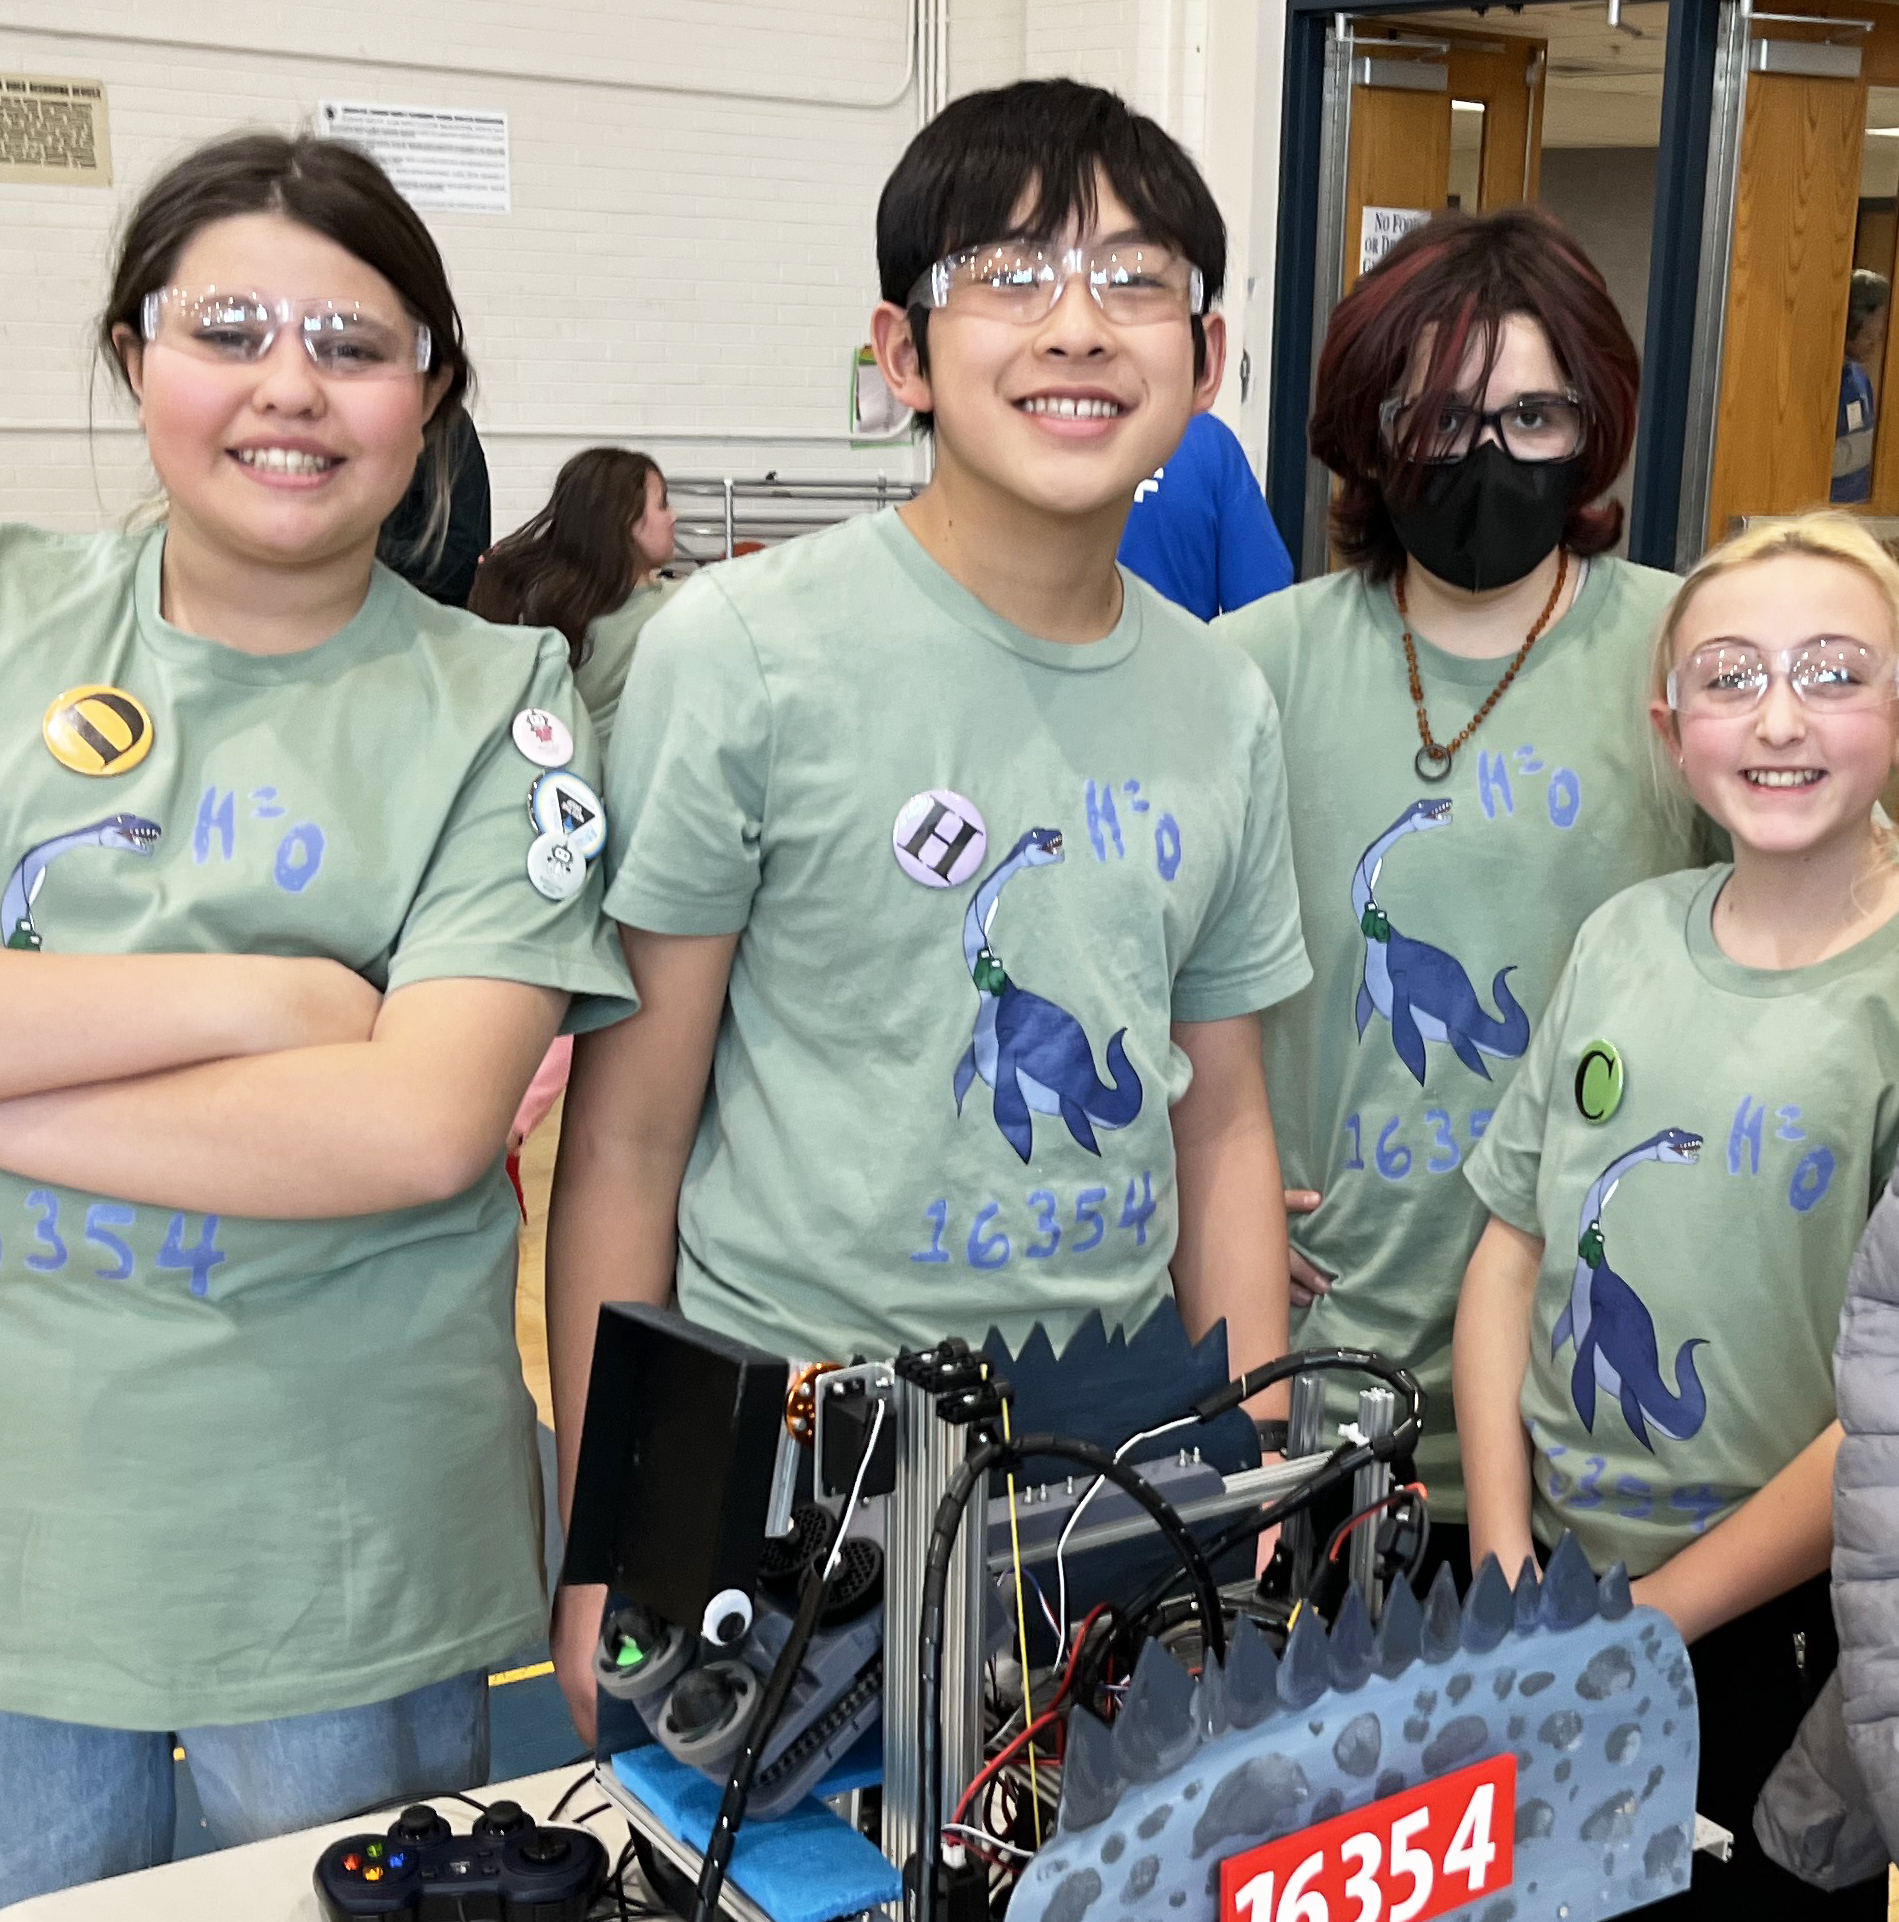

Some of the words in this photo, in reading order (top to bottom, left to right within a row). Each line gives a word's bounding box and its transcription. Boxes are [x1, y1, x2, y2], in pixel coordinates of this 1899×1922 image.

[62, 693, 144, 769] D
[897, 795, 983, 883] H
[1575, 1051, 1615, 1120] C
[0, 1190, 226, 1297] 354
[910, 1171, 1156, 1269] 16354
